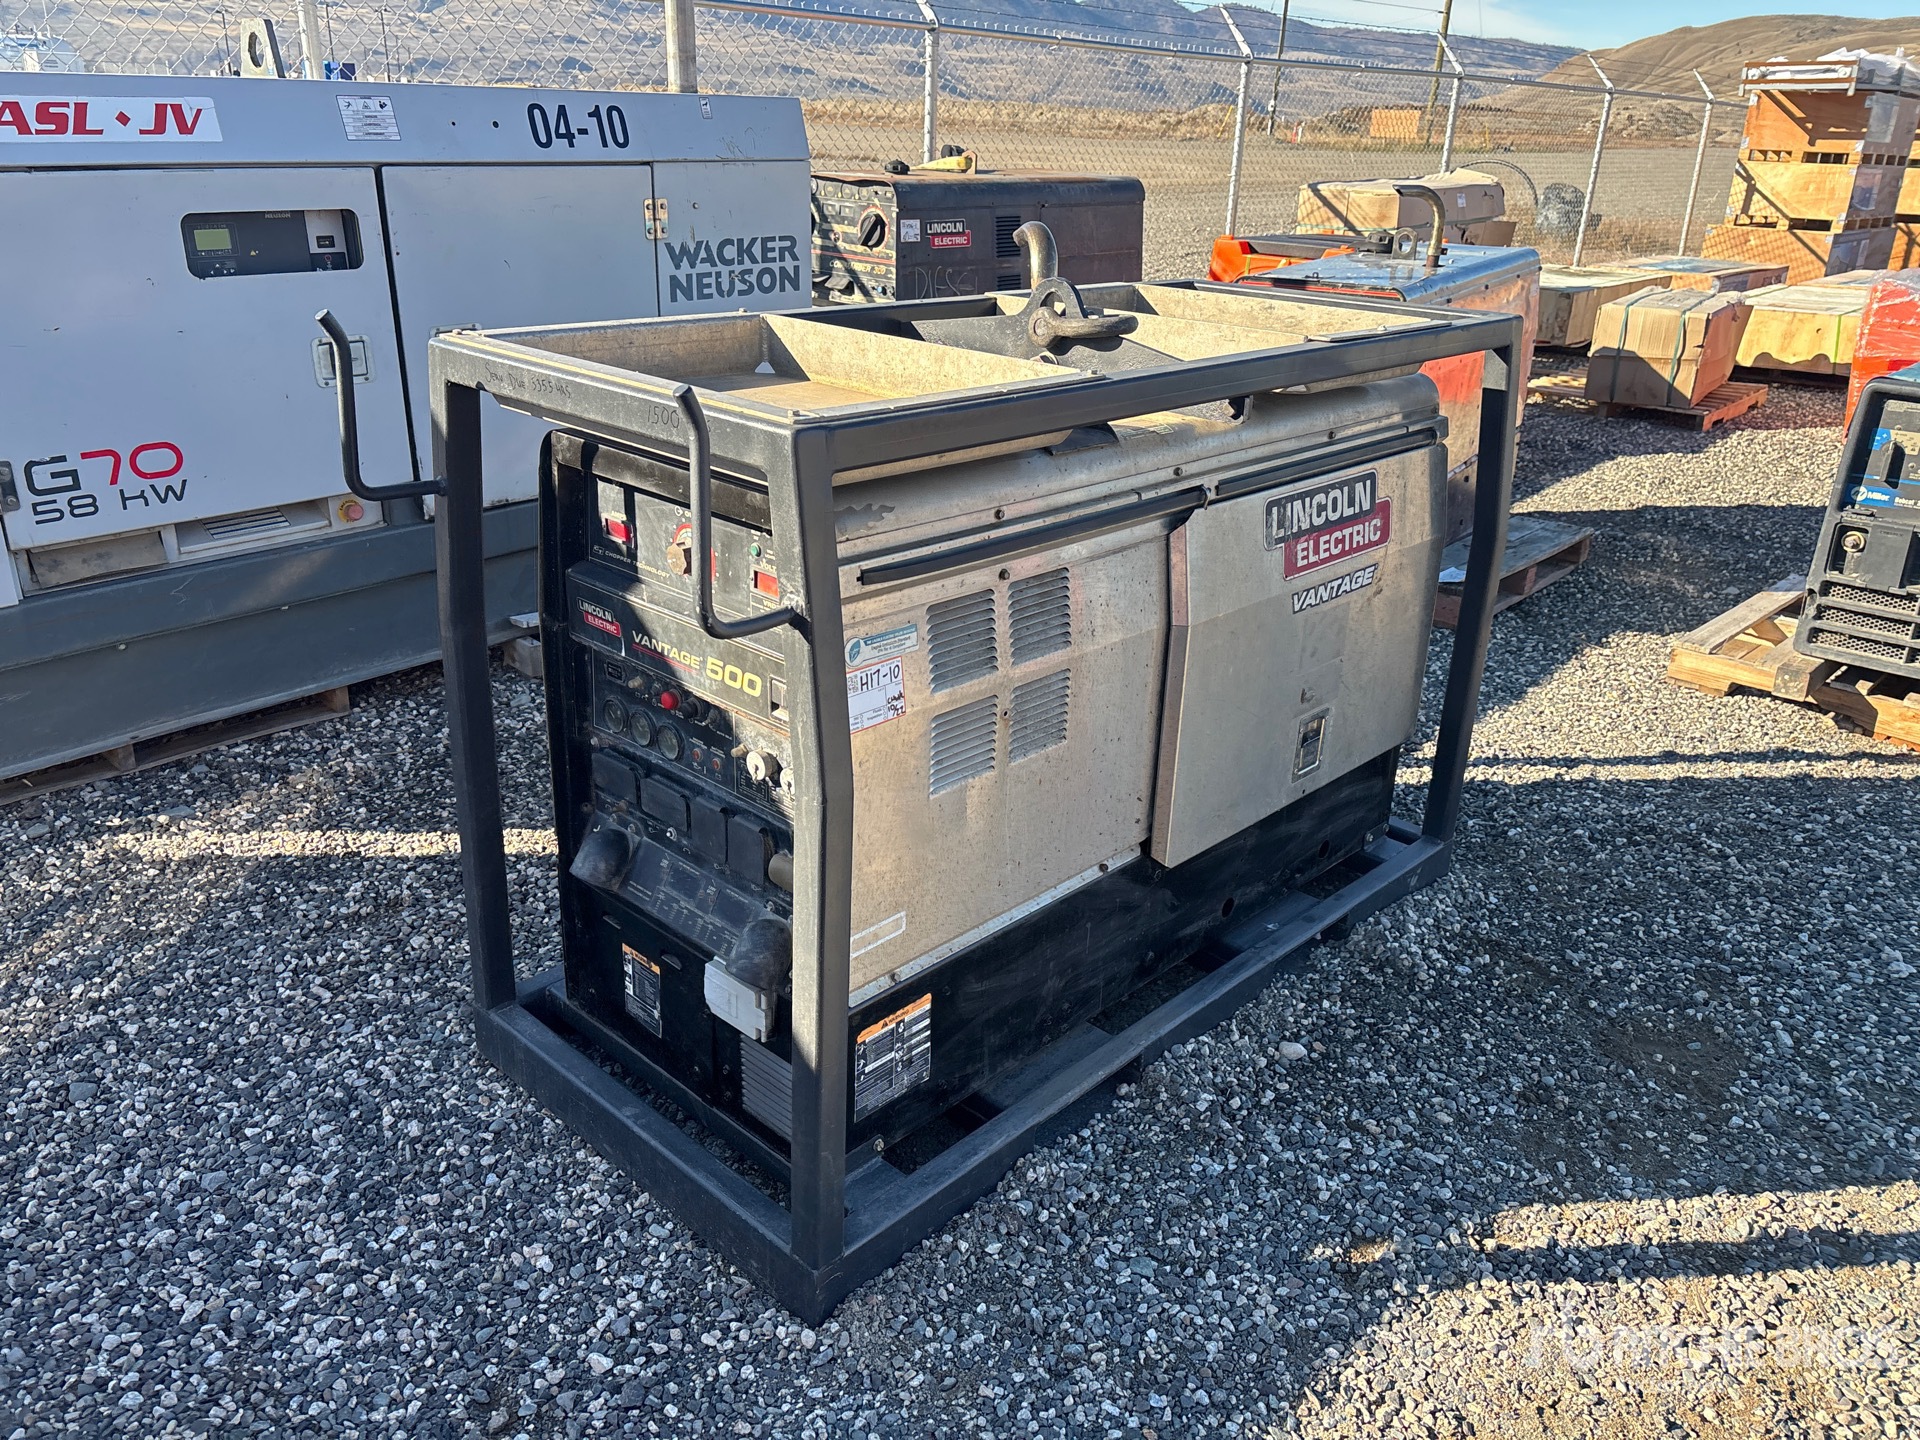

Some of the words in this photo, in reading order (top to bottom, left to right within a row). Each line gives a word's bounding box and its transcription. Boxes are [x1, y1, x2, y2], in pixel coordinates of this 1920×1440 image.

[139, 103, 203, 136] JV
[526, 102, 630, 149] 04-10
[927, 222, 963, 234] LINCOLN
[934, 236, 968, 246] ELECTRIC
[664, 235, 800, 271] WACKER
[669, 264, 801, 303] NEUSON
[647, 404, 680, 428] 1500
[23, 440, 184, 497] G70
[31, 493, 99, 525] 58
[1270, 479, 1372, 539] LINCOLN
[1867, 490, 1890, 502] Miller
[1296, 519, 1381, 568] ELECTRIC
[605, 550, 631, 564] CHOPPER
[632, 559, 671, 578] TECHNOLOGY
[760, 560, 777, 572] VOLT
[1292, 565, 1377, 613] VANTAGE
[579, 600, 612, 622] LINCOLN
[587, 615, 617, 633] ELECTRIC
[632, 630, 701, 670] VANTAGE
[706, 655, 762, 698] 500
[860, 664, 900, 692] H17-10
